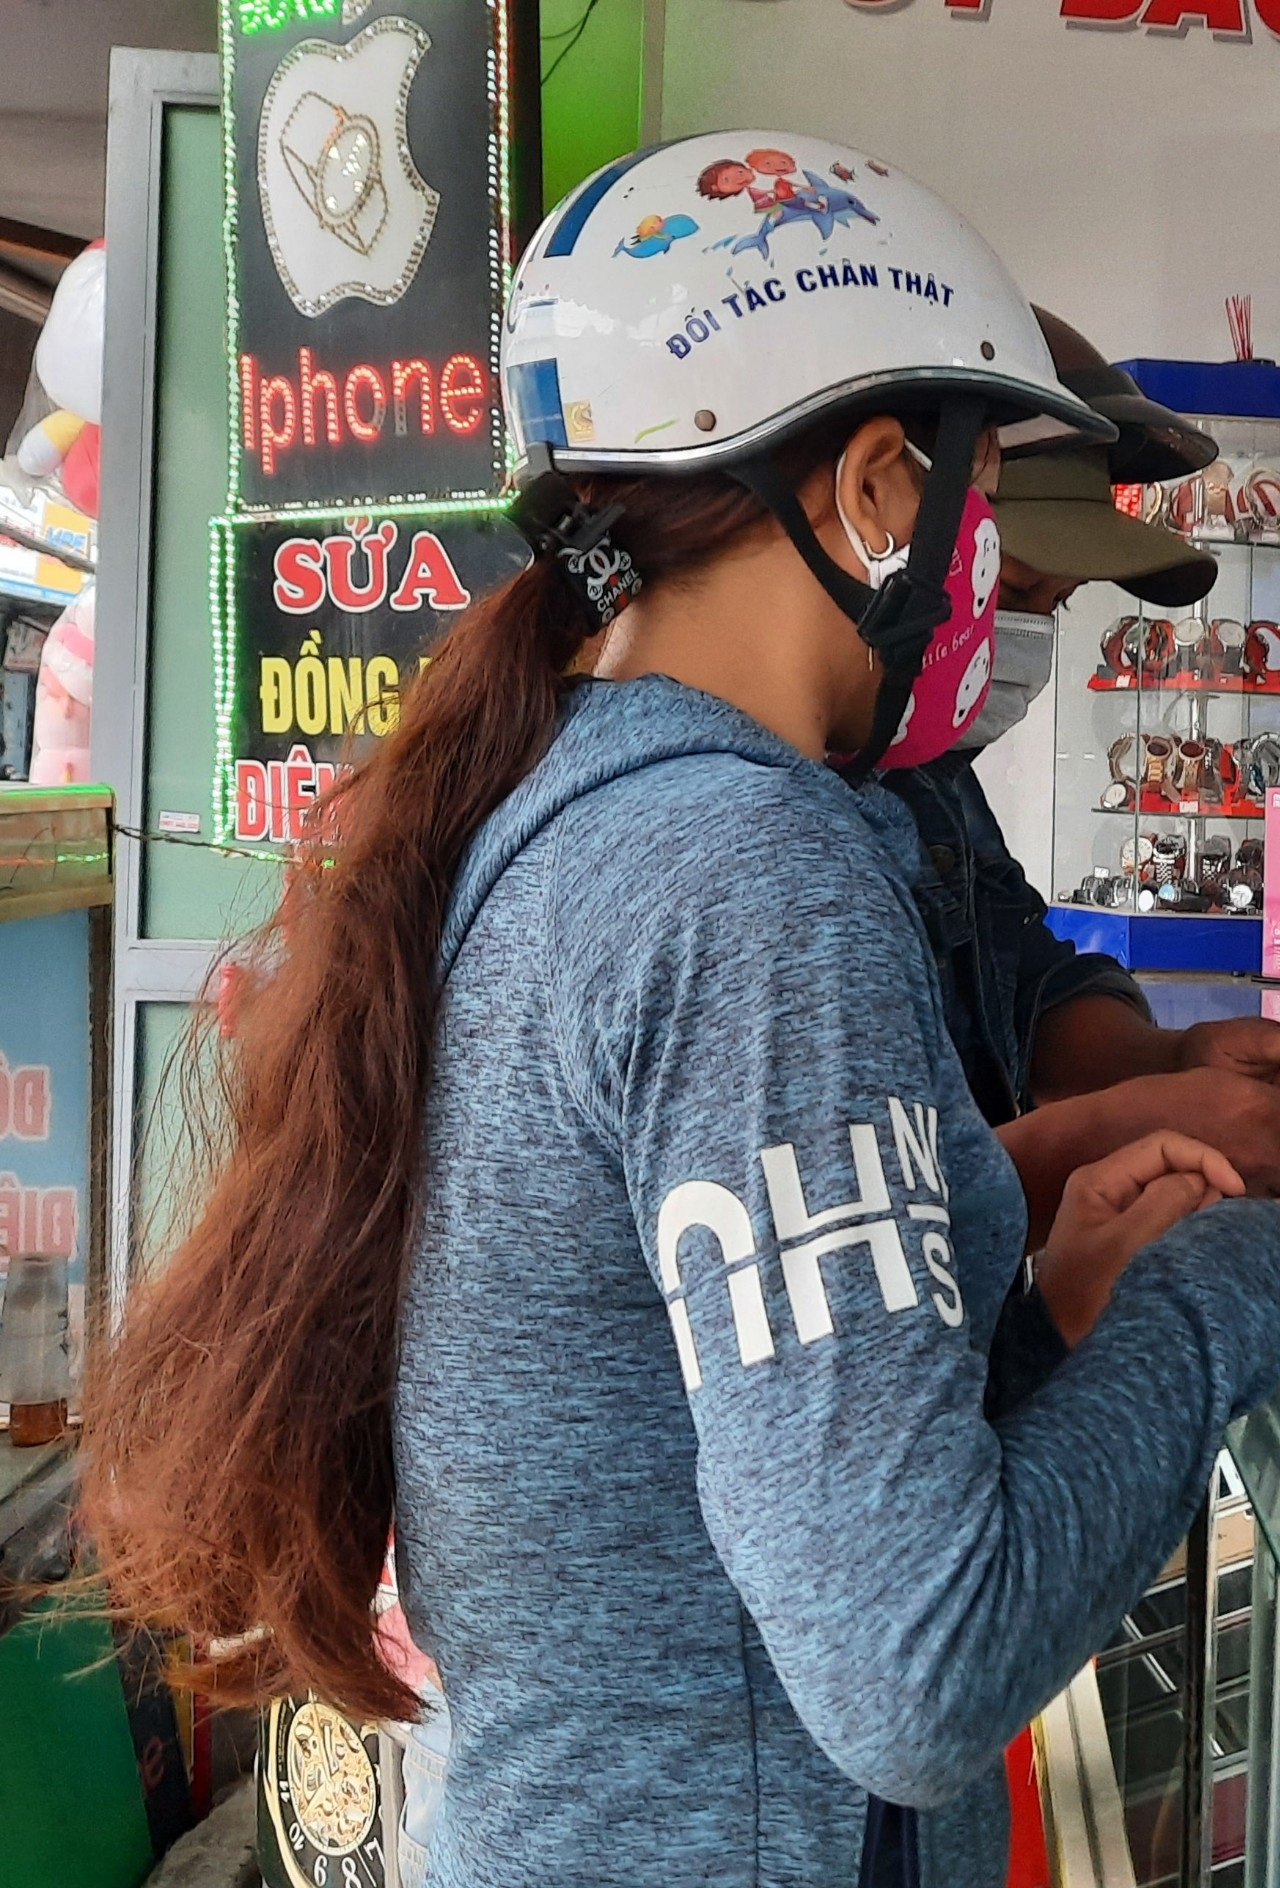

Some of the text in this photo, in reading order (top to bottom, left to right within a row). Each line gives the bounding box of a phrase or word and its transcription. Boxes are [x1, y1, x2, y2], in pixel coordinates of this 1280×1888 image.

[665, 258, 955, 359] ĐỐI TÁC CHÂN THẬT
[273, 513, 471, 614] SỬA
[597, 568, 640, 612] CHANEL
[260, 629, 402, 737] ĐỒNG
